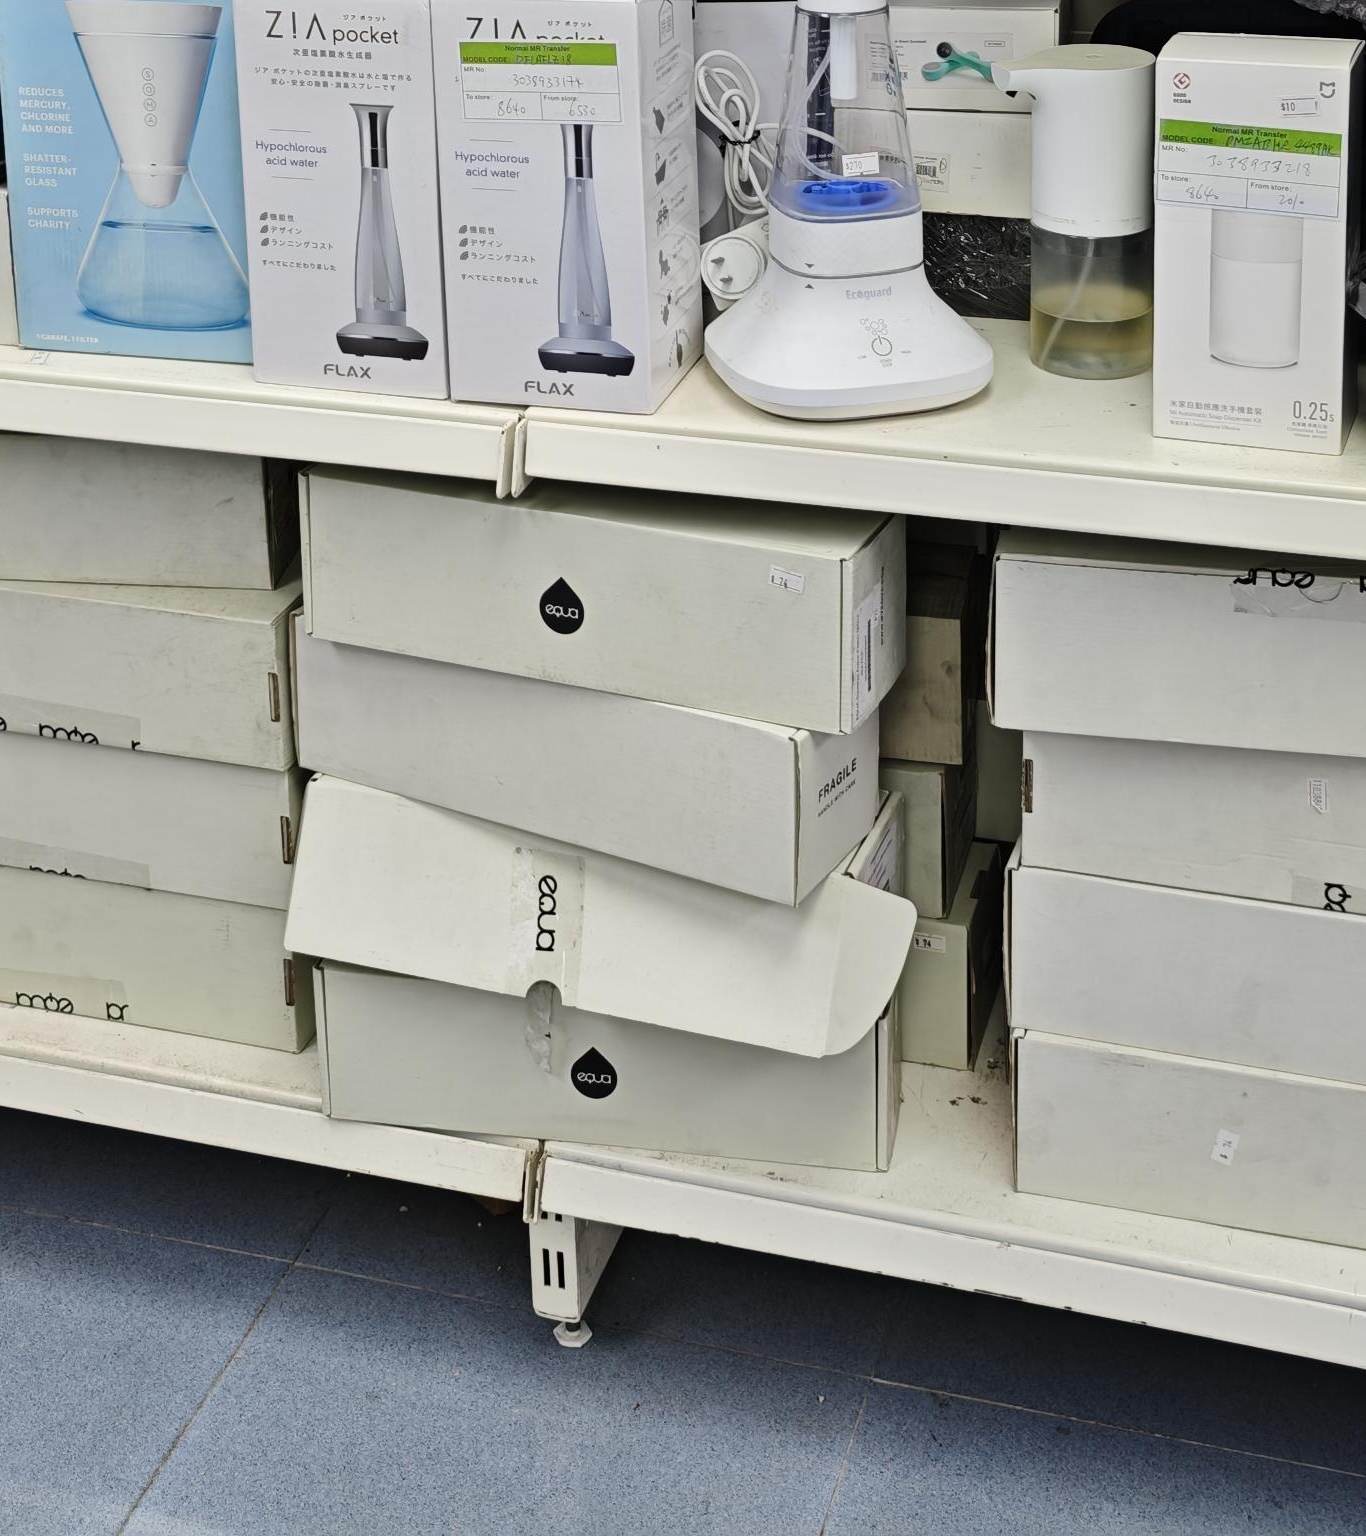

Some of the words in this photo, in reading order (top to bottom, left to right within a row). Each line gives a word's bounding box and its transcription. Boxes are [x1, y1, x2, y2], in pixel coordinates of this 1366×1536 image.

[18, 87, 64, 97] REDUCES
[1280, 102, 1296, 112] $10
[20, 112, 71, 122] CHLORINE
[21, 124, 42, 133] AND
[45, 125, 73, 135] MORE
[255, 140, 327, 155] Hypochlorous
[23, 153, 71, 163] SHATTER-
[266, 155, 285, 167] acid
[287, 157, 318, 168] water
[455, 151, 530, 166] Hypochlorous
[24, 165, 77, 176] RESISTANT
[465, 166, 485, 178] acid
[487, 168, 520, 180] water
[25, 177, 57, 187] GLASS
[27, 206, 79, 218] SUPPORTS
[27, 219, 70, 230] CHARITY
[471, 251, 537, 264] ランニングコスト
[845, 285, 893, 300] Ecoguard
[323, 364, 372, 380] FLAX
[524, 381, 574, 397] FLAX
[1292, 400, 1334, 422] 0.25s
[545, 604, 578, 621] equa
[817, 757, 858, 804] FRAGILE
[535, 874, 558, 953] equa
[577, 1071, 612, 1086] equa
